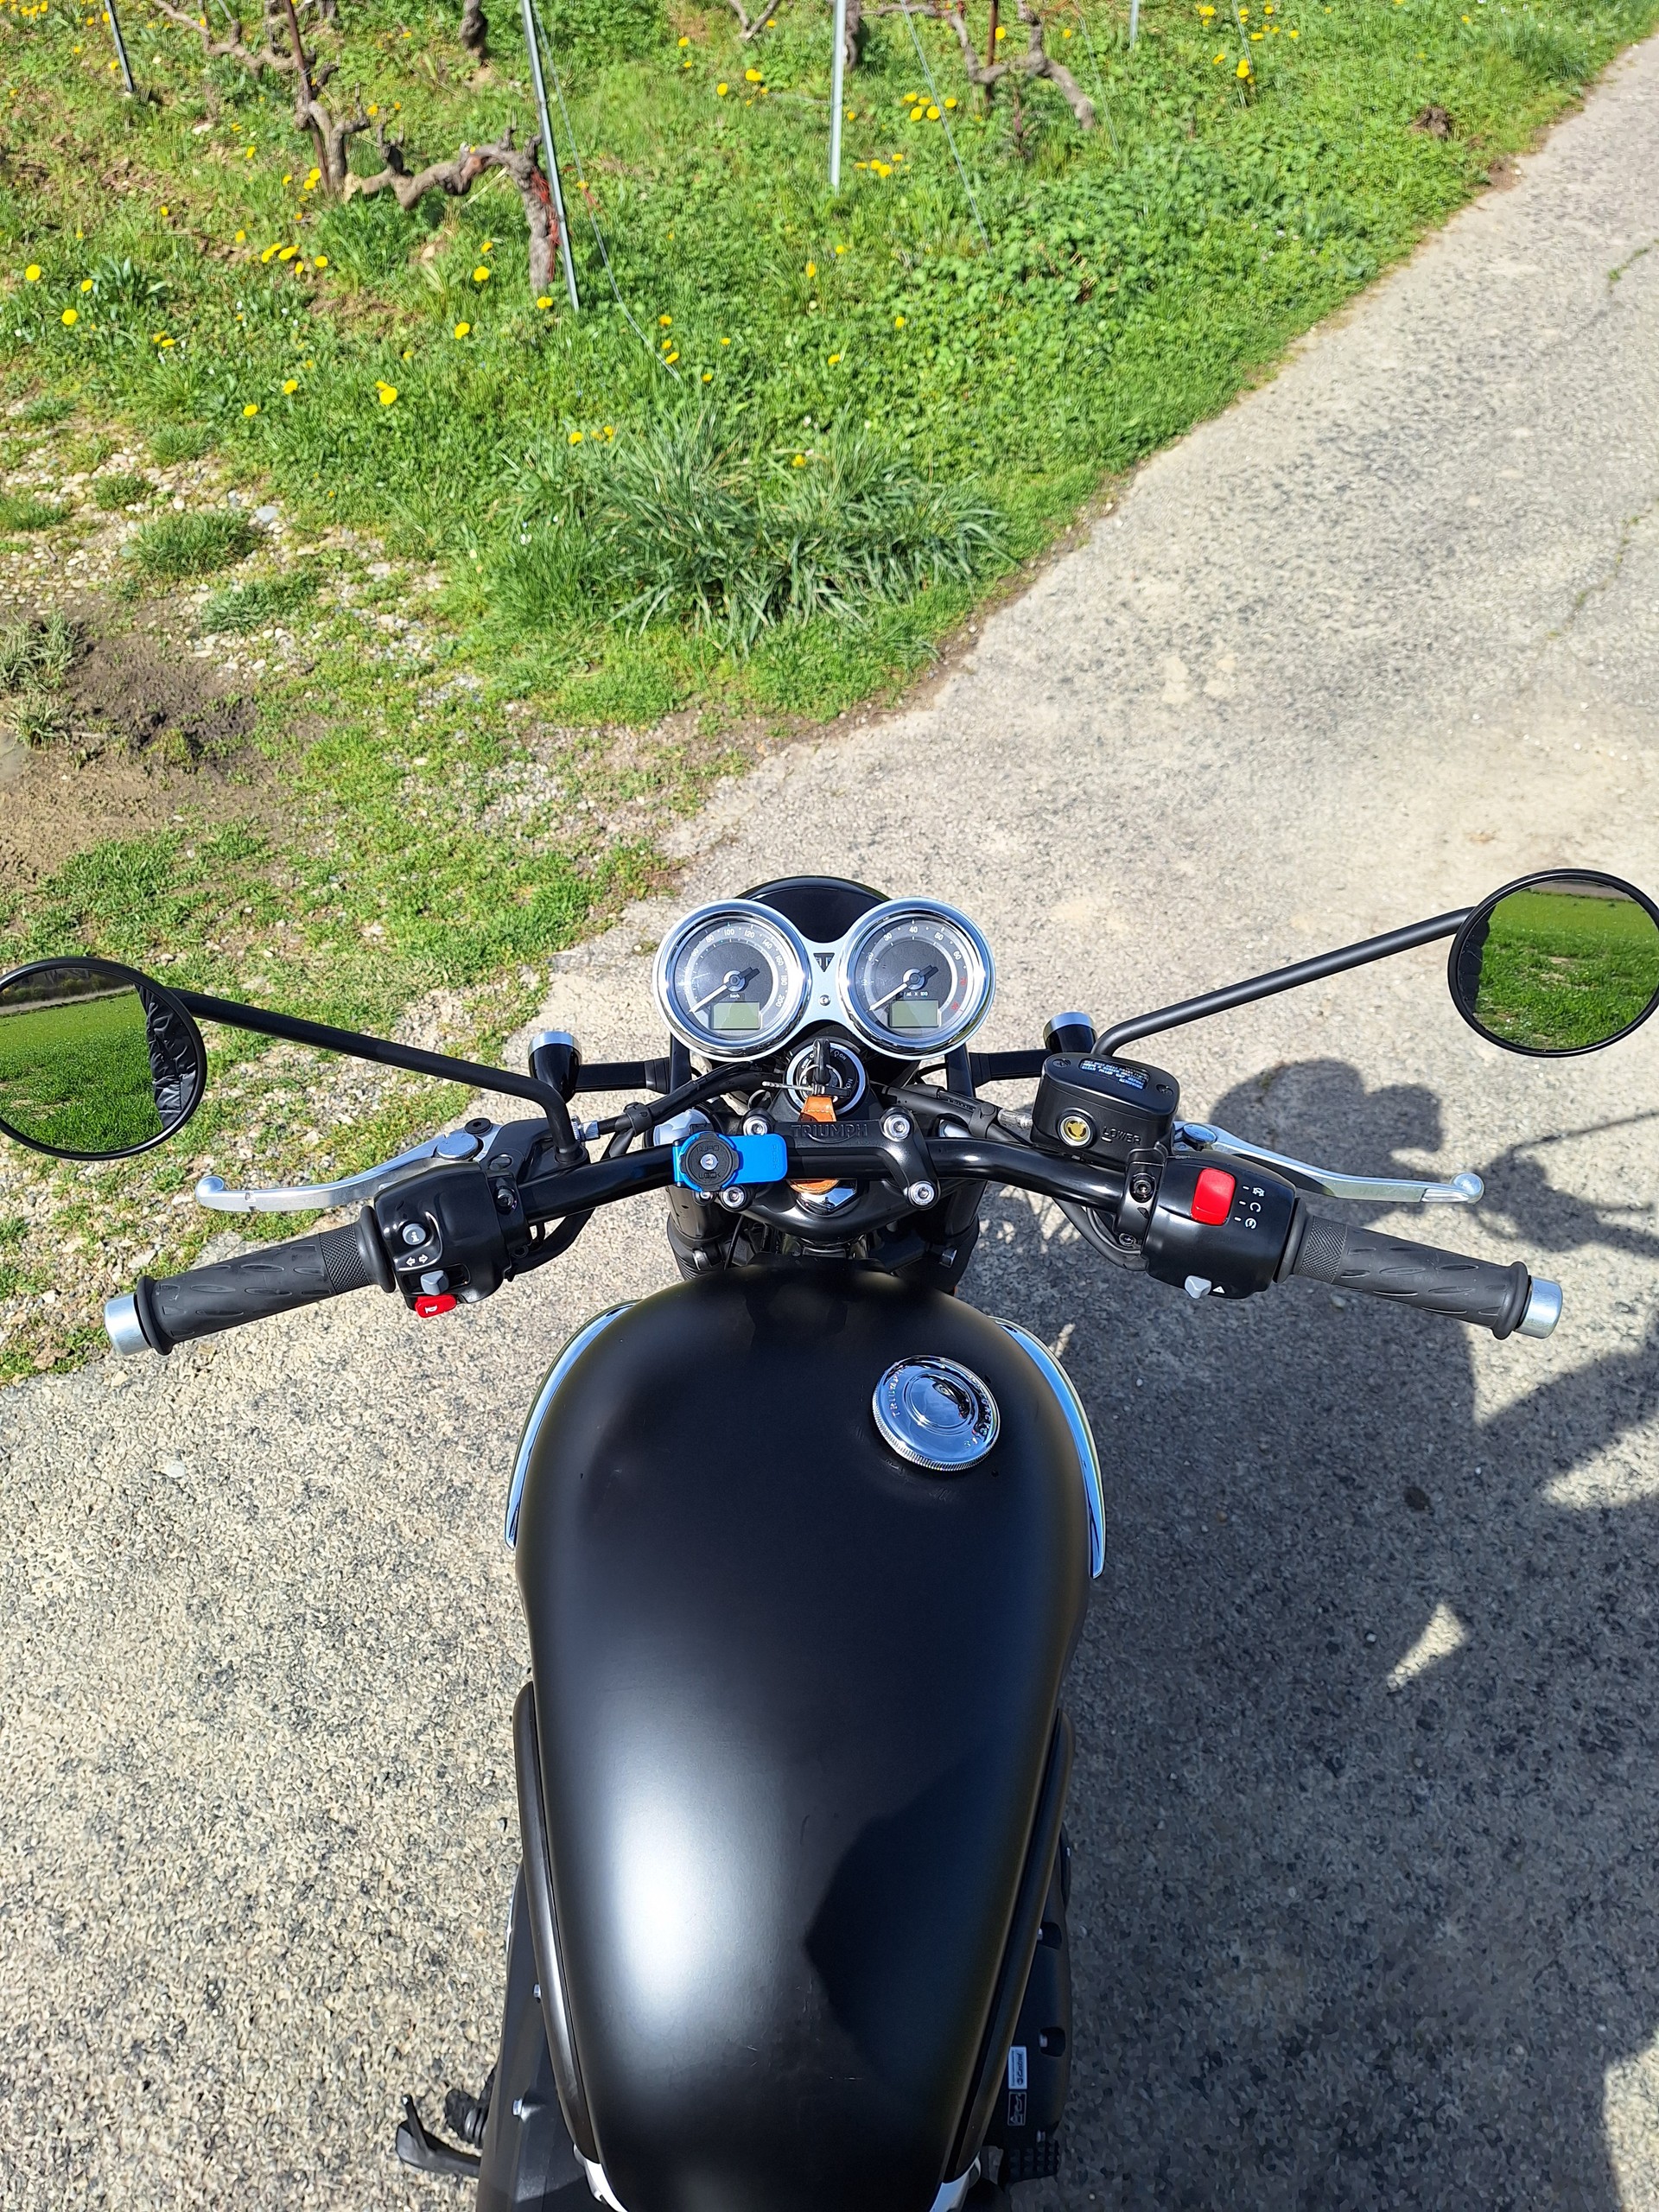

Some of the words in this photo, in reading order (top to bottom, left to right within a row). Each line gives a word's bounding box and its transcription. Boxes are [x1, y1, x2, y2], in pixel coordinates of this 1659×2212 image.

[744, 929, 755, 938] 120
[934, 932, 944, 941] 50
[761, 938, 773, 950] 140
[953, 950, 962, 960] 60
[775, 956, 785, 966] 160
[775, 994, 785, 1007] 200
[791, 1123, 868, 1142] TRIUMPH
[1103, 1126, 1141, 1145] LOWER
[696, 1144, 720, 1153] QUAD
